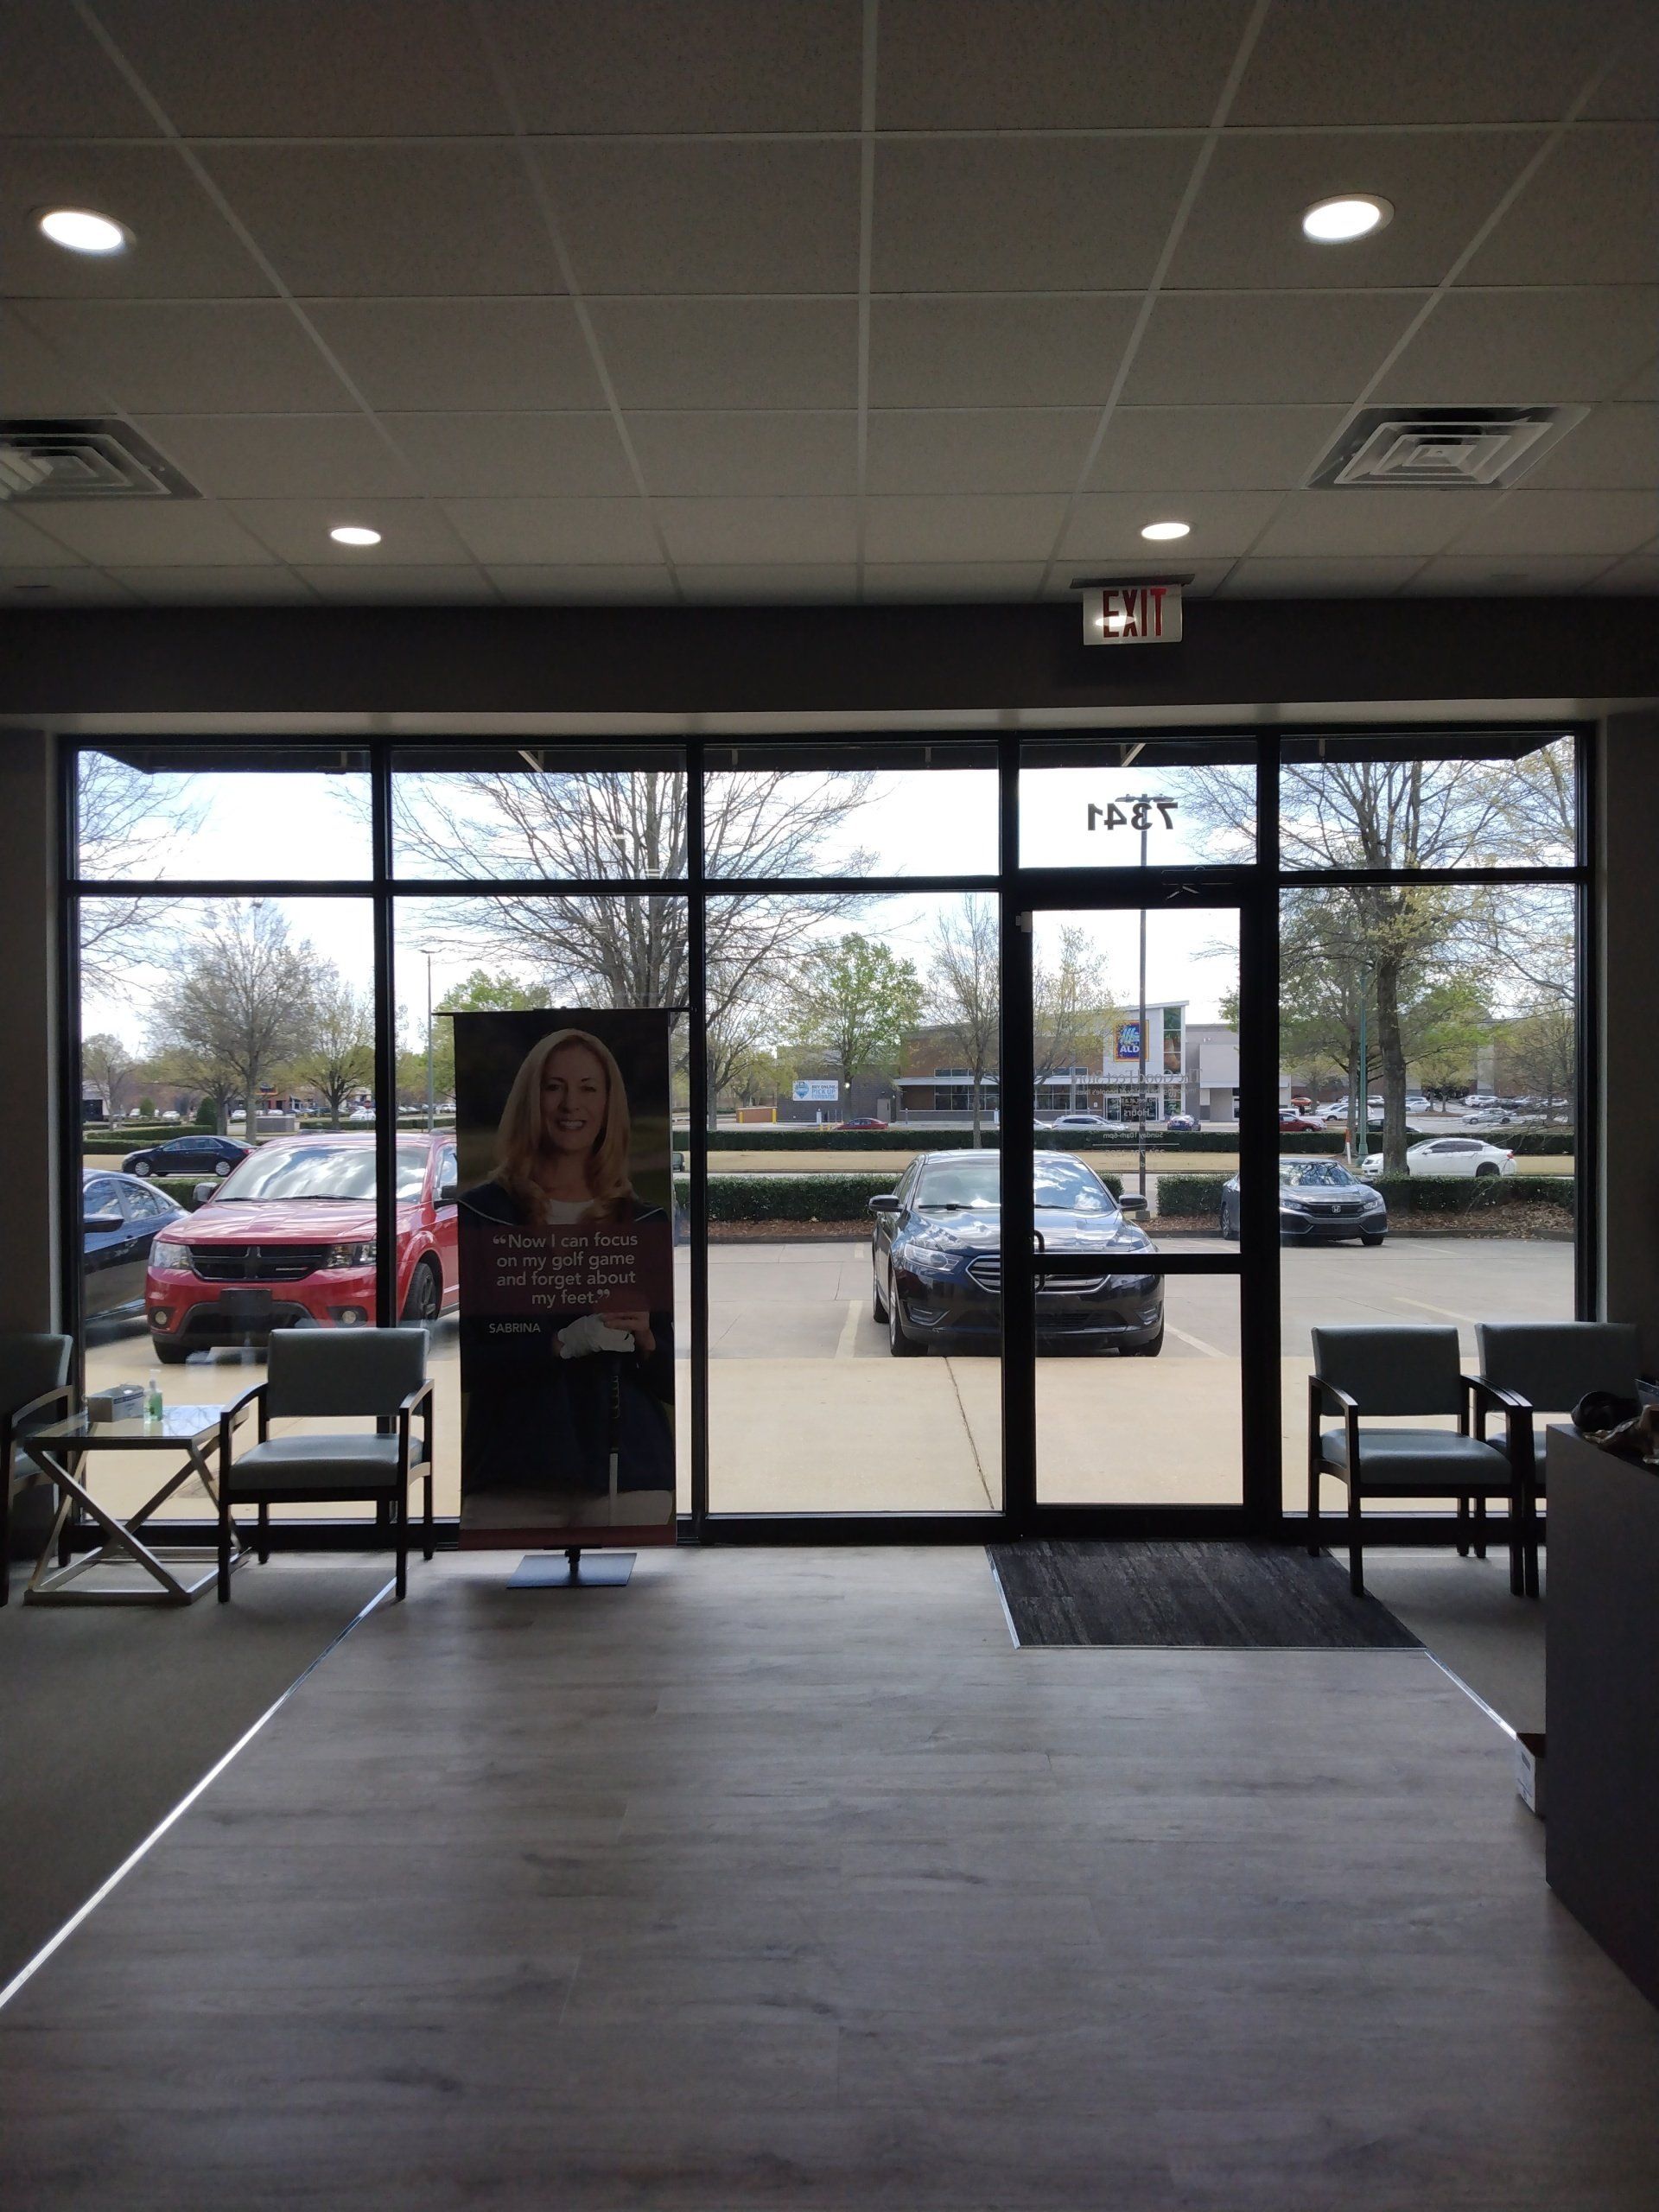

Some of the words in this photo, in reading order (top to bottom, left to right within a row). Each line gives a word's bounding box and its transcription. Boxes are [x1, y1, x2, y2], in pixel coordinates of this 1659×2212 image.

[1103, 588, 1166, 638] EXIT
[551, 1234, 555, 1247] I
[561, 1236, 588, 1248] can
[594, 1231, 638, 1246] focus
[496, 1256, 517, 1268] on
[522, 1255, 546, 1269] my
[551, 1251, 584, 1271] golf
[588, 1253, 635, 1270] game
[496, 1272, 526, 1286] and
[531, 1271, 582, 1289] forget
[587, 1270, 636, 1285] about
[531, 1294, 556, 1308] my
[489, 1323, 541, 1334] SABRINA
